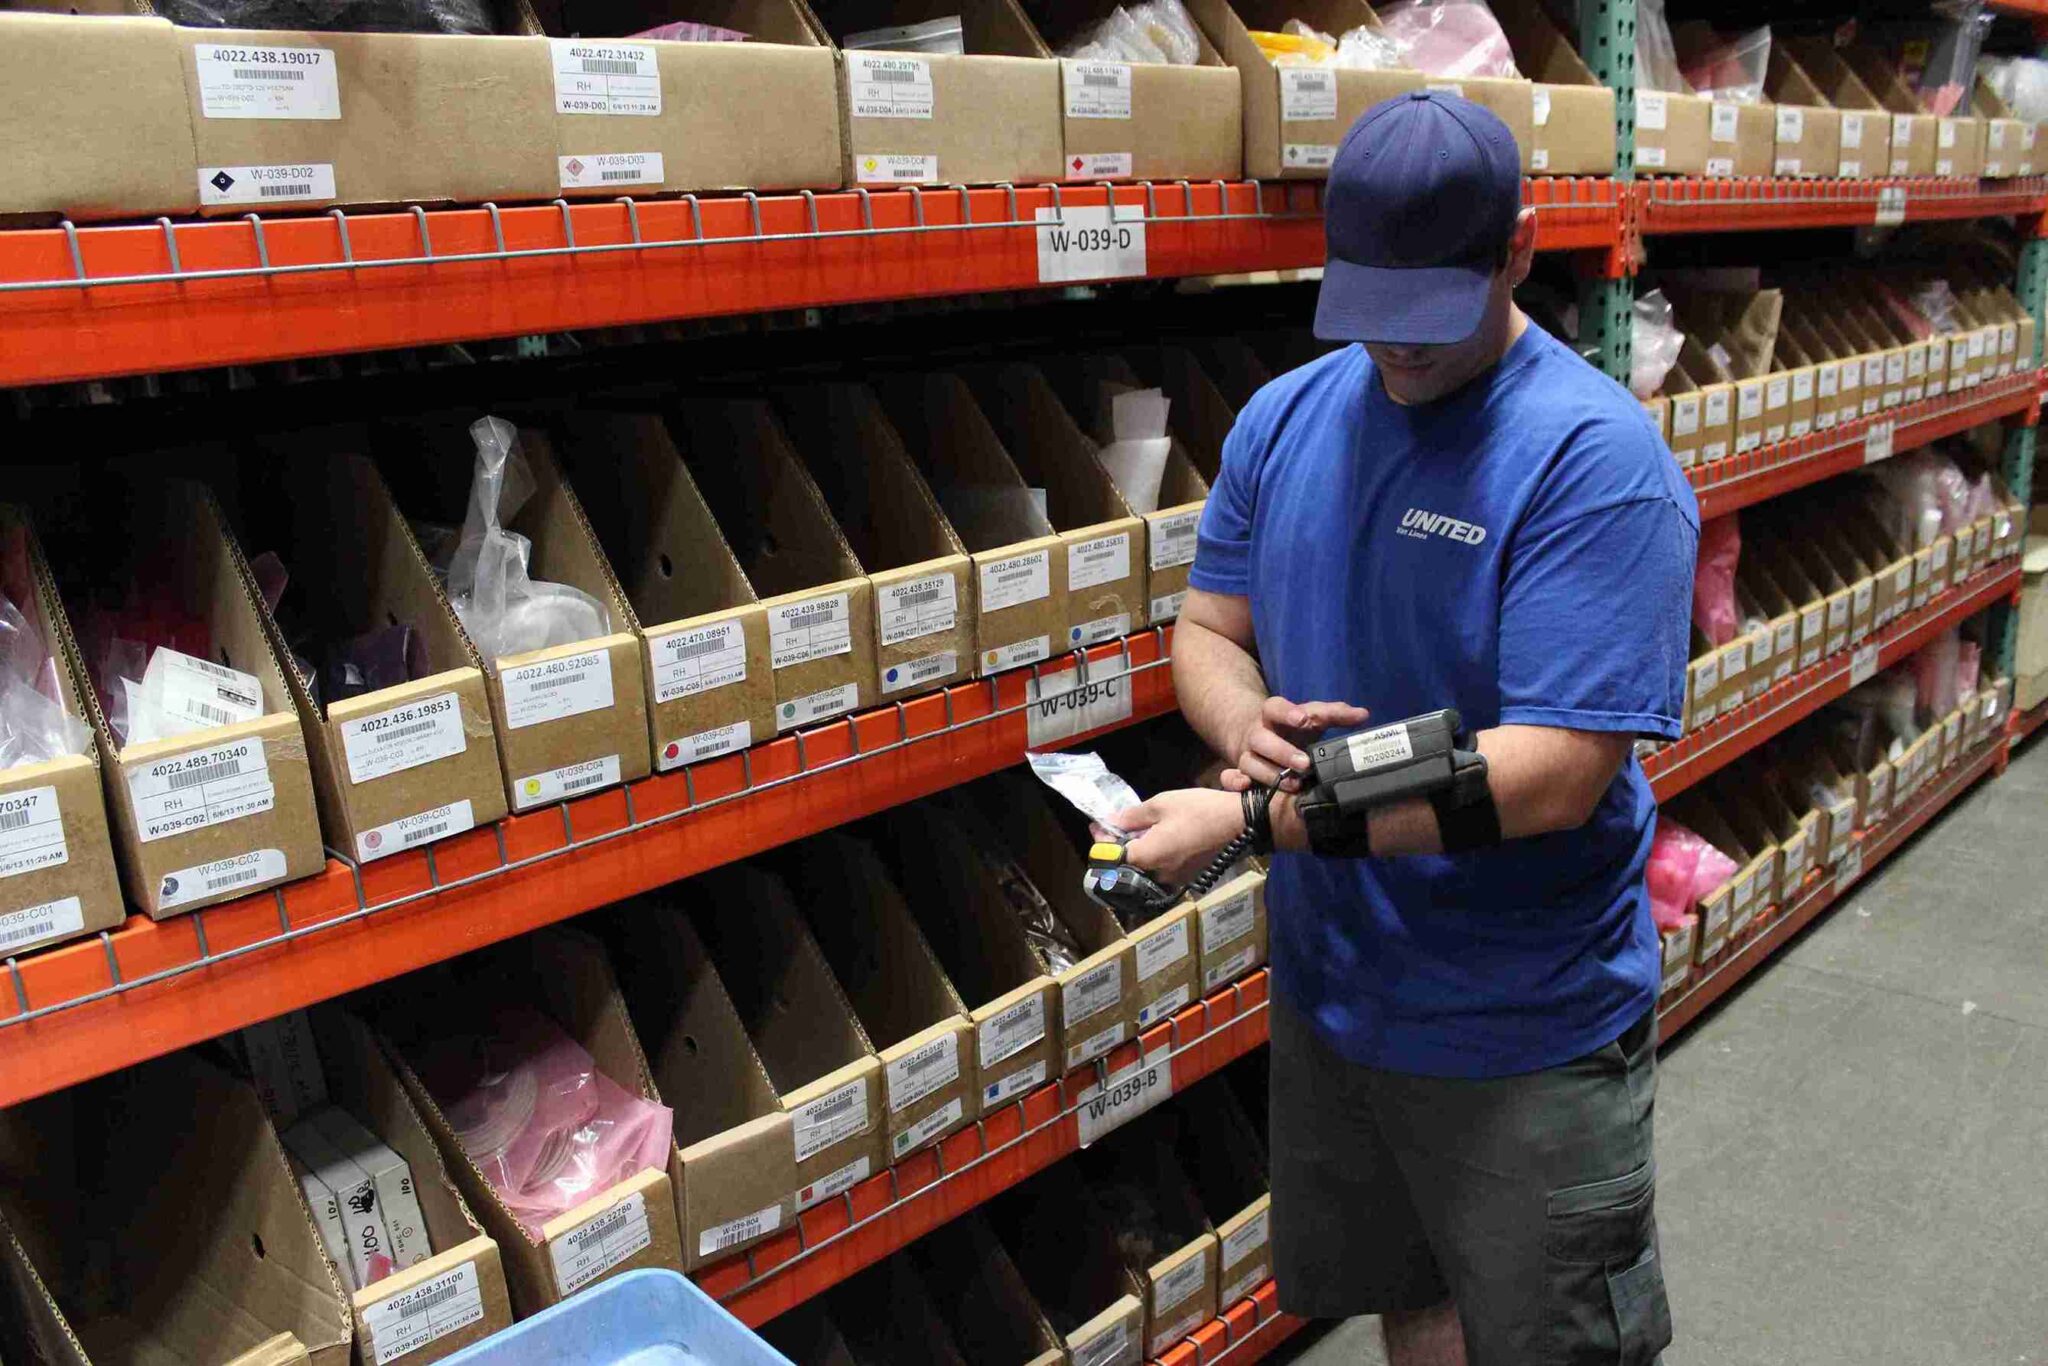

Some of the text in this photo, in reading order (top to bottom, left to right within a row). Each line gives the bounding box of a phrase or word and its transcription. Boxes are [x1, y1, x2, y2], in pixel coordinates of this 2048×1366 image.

[213, 49, 321, 65] 4022.438.19017
[569, 48, 645, 61] 4022.472.31432
[576, 81, 592, 91] RH
[562, 100, 607, 111] W-039-D03
[597, 155, 645, 166] W-039-D03
[251, 167, 313, 180] W-039-D02
[1050, 228, 1131, 253] W-039-D
[1401, 508, 1487, 546] UNITED
[516, 654, 600, 681] 4022.480.92085
[673, 668, 686, 679] RH
[1040, 679, 1117, 718] W-039-C
[360, 700, 451, 734] 4022.436.19853
[692, 726, 734, 744] W-039-C05
[151, 746, 248, 778] 4022.489.70340
[555, 760, 604, 780] W-039-C04
[163, 799, 183, 812] RH
[148, 814, 206, 836] W-039-C02
[256, 798, 270, 810] AM
[398, 807, 451, 830] W-039-C03
[50, 850, 63, 861] AM
[197, 853, 261, 877] W-039-C02
[1088, 1069, 1158, 1120] W-039-B
[576, 1255, 590, 1269] RH
[387, 1271, 464, 1312] 4022.438.31100
[395, 1323, 412, 1337] RH
[383, 1333, 429, 1359] W-039-B02
